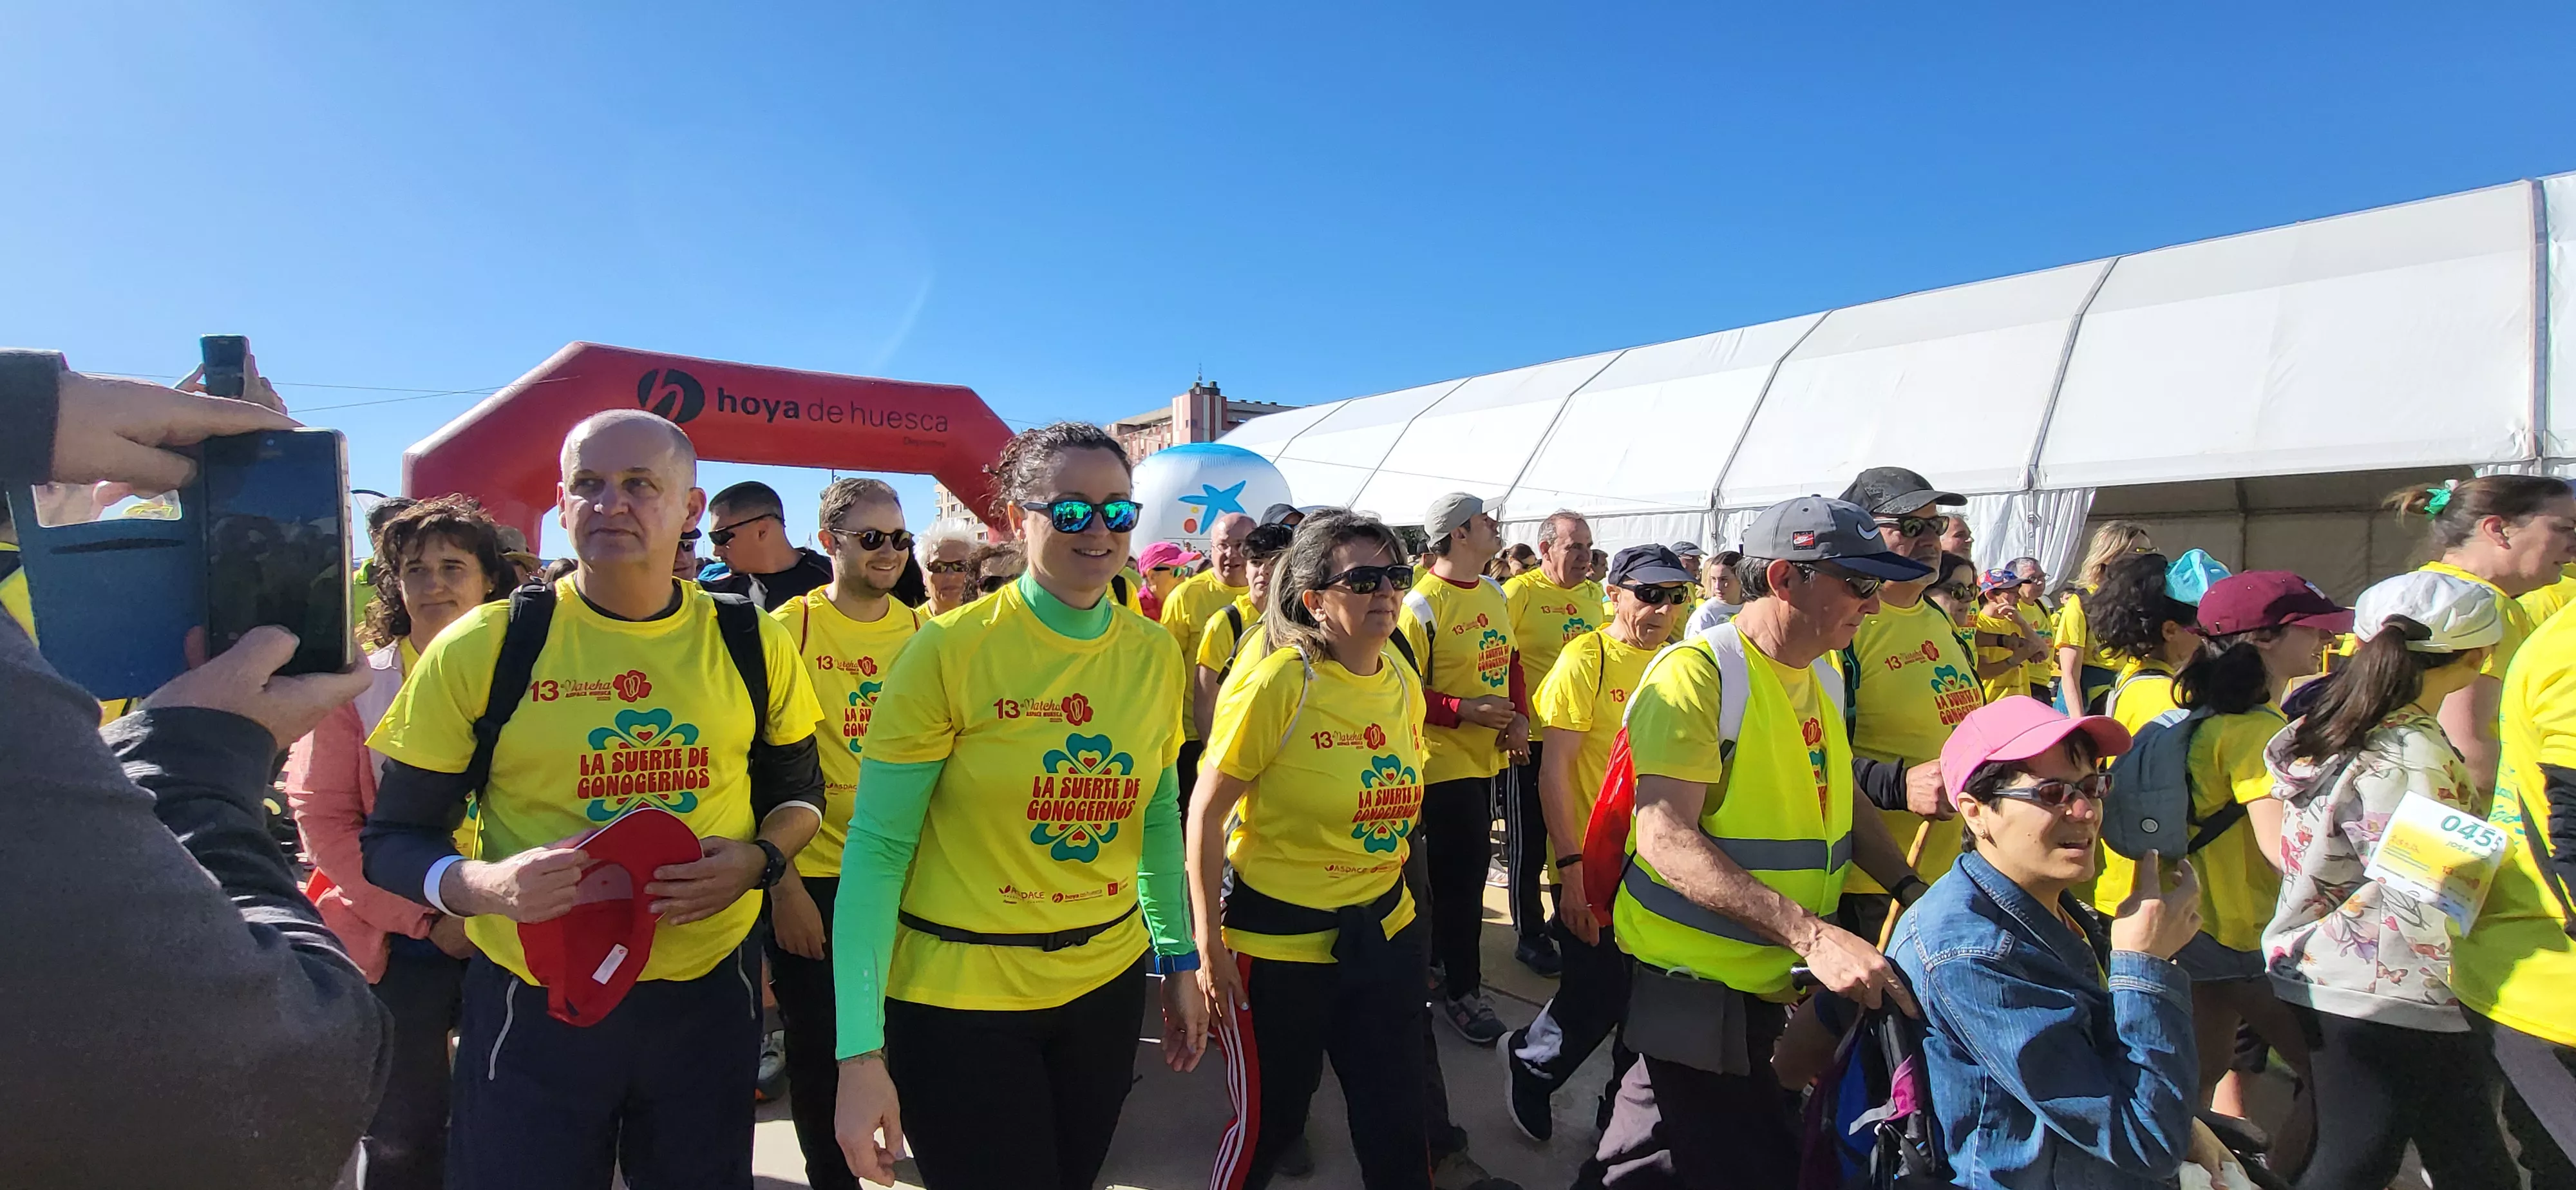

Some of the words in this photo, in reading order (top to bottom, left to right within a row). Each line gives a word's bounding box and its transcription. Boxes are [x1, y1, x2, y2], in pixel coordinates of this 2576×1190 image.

[717, 387, 800, 423] hoya
[808, 397, 844, 423] de
[850, 401, 949, 432] huesca
[1540, 605, 1551, 614] 13
[1452, 625, 1464, 636] 13
[816, 655, 834, 670] 13
[1884, 656, 1902, 671] 13
[531, 679, 560, 702] 13
[1610, 689, 1625, 703] 13
[844, 708, 857, 722] LA
[993, 697, 1021, 719] 13
[1310, 731, 1333, 750] 13
[580, 753, 605, 776] LA
[612, 748, 682, 774] SUERTE
[688, 747, 709, 768] DE
[1032, 776, 1054, 798] LA
[1059, 777, 1120, 800] SUERTE
[1122, 778, 1141, 799] DE
[1359, 791, 1372, 809] LA
[1375, 787, 1412, 807] SUERTE
